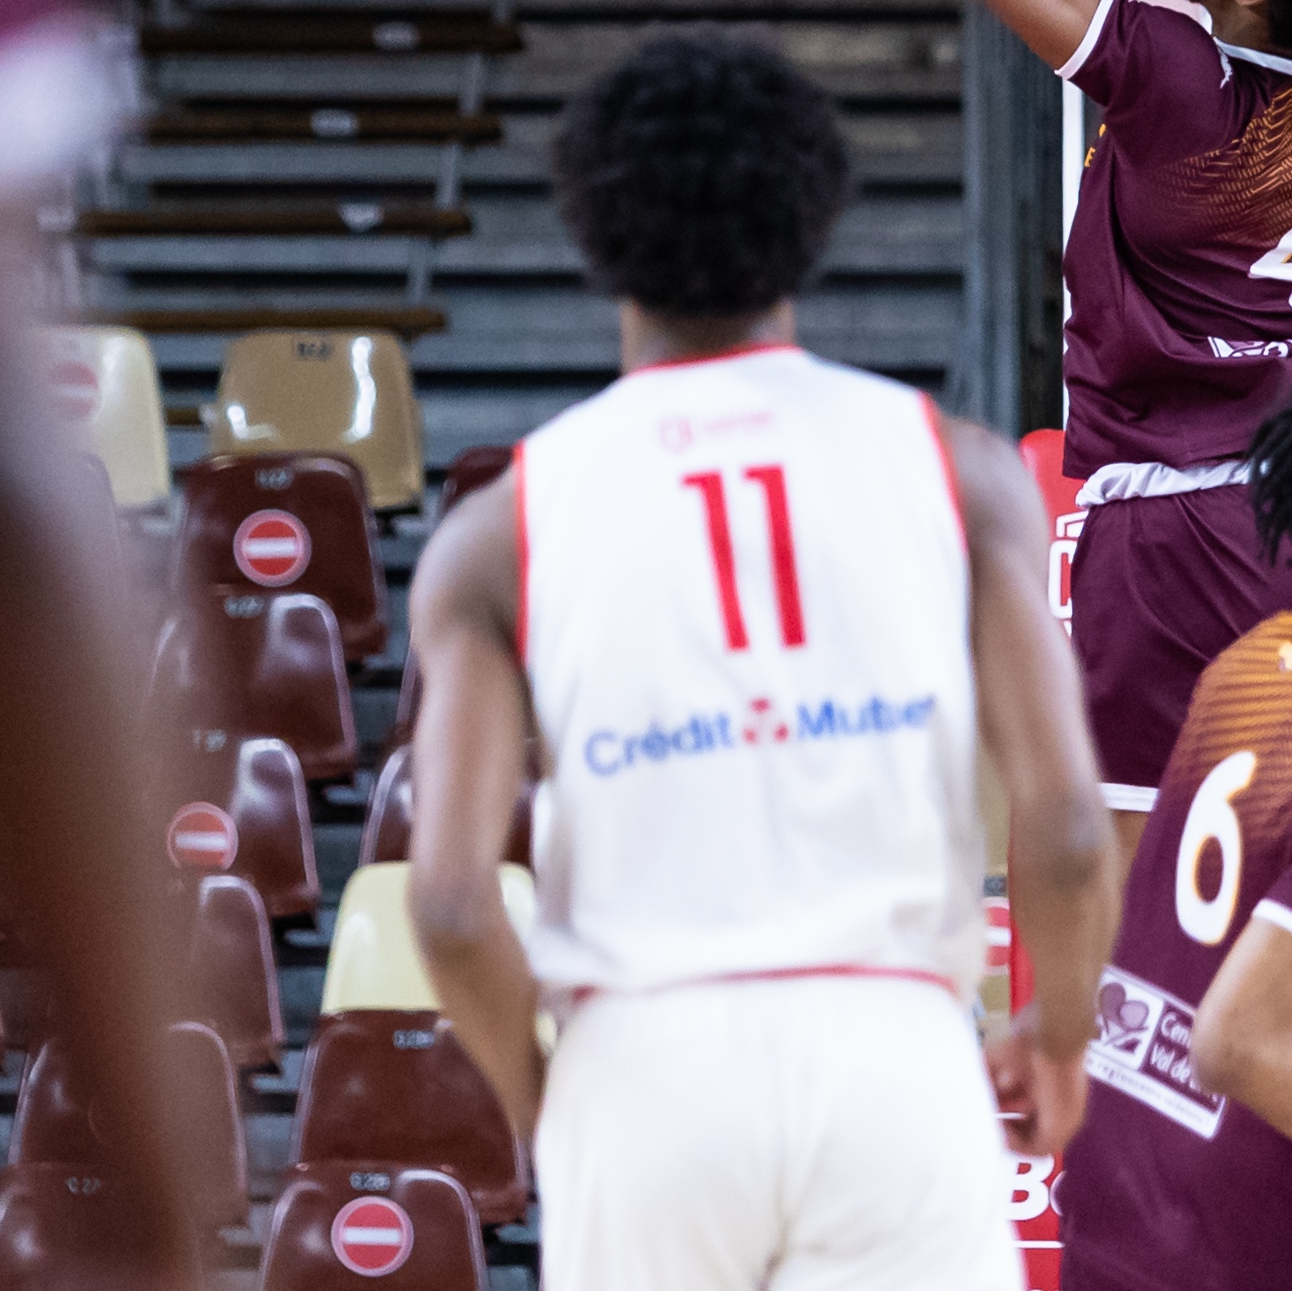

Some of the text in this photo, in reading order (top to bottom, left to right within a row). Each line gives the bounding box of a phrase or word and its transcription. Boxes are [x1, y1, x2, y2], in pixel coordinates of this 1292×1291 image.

[681, 464, 807, 653] 11
[583, 710, 735, 778] Crédit
[1174, 750, 1259, 946] 6
